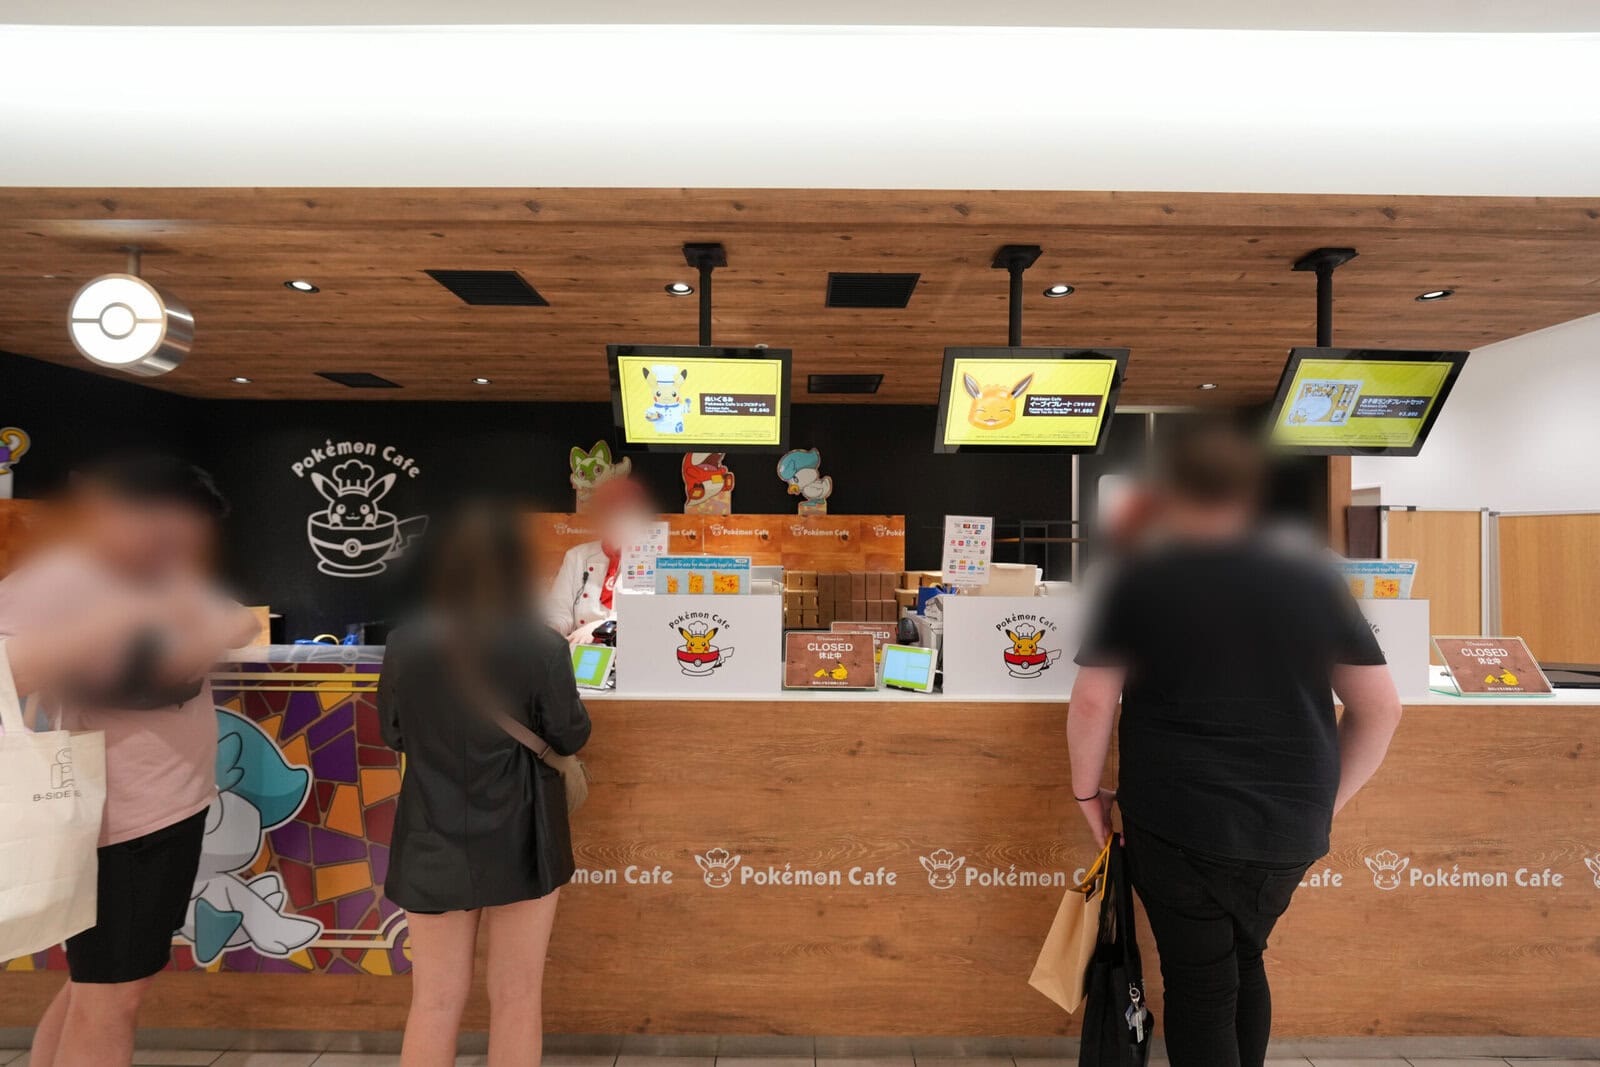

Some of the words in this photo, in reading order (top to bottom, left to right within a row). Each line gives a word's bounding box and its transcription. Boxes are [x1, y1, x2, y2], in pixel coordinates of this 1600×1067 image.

[292, 439, 376, 477] Pokémon
[382, 446, 420, 478] Cafe
[669, 611, 709, 629] Pokémon
[712, 614, 730, 630] Cafe
[996, 613, 1036, 631] Pokémon
[1039, 616, 1057, 632] Cafe
[807, 643, 853, 652] CLOSED
[819, 652, 842, 660] 休止中
[1461, 648, 1509, 657] CLOSED
[624, 865, 673, 885] Cafe
[740, 862, 841, 885] Pokémon
[848, 865, 897, 885] Cafe
[965, 863, 1065, 887] Pokémon
[1299, 868, 1343, 887] afe
[1410, 864, 1508, 887] Pokémon
[1515, 868, 1563, 887] Cafe
